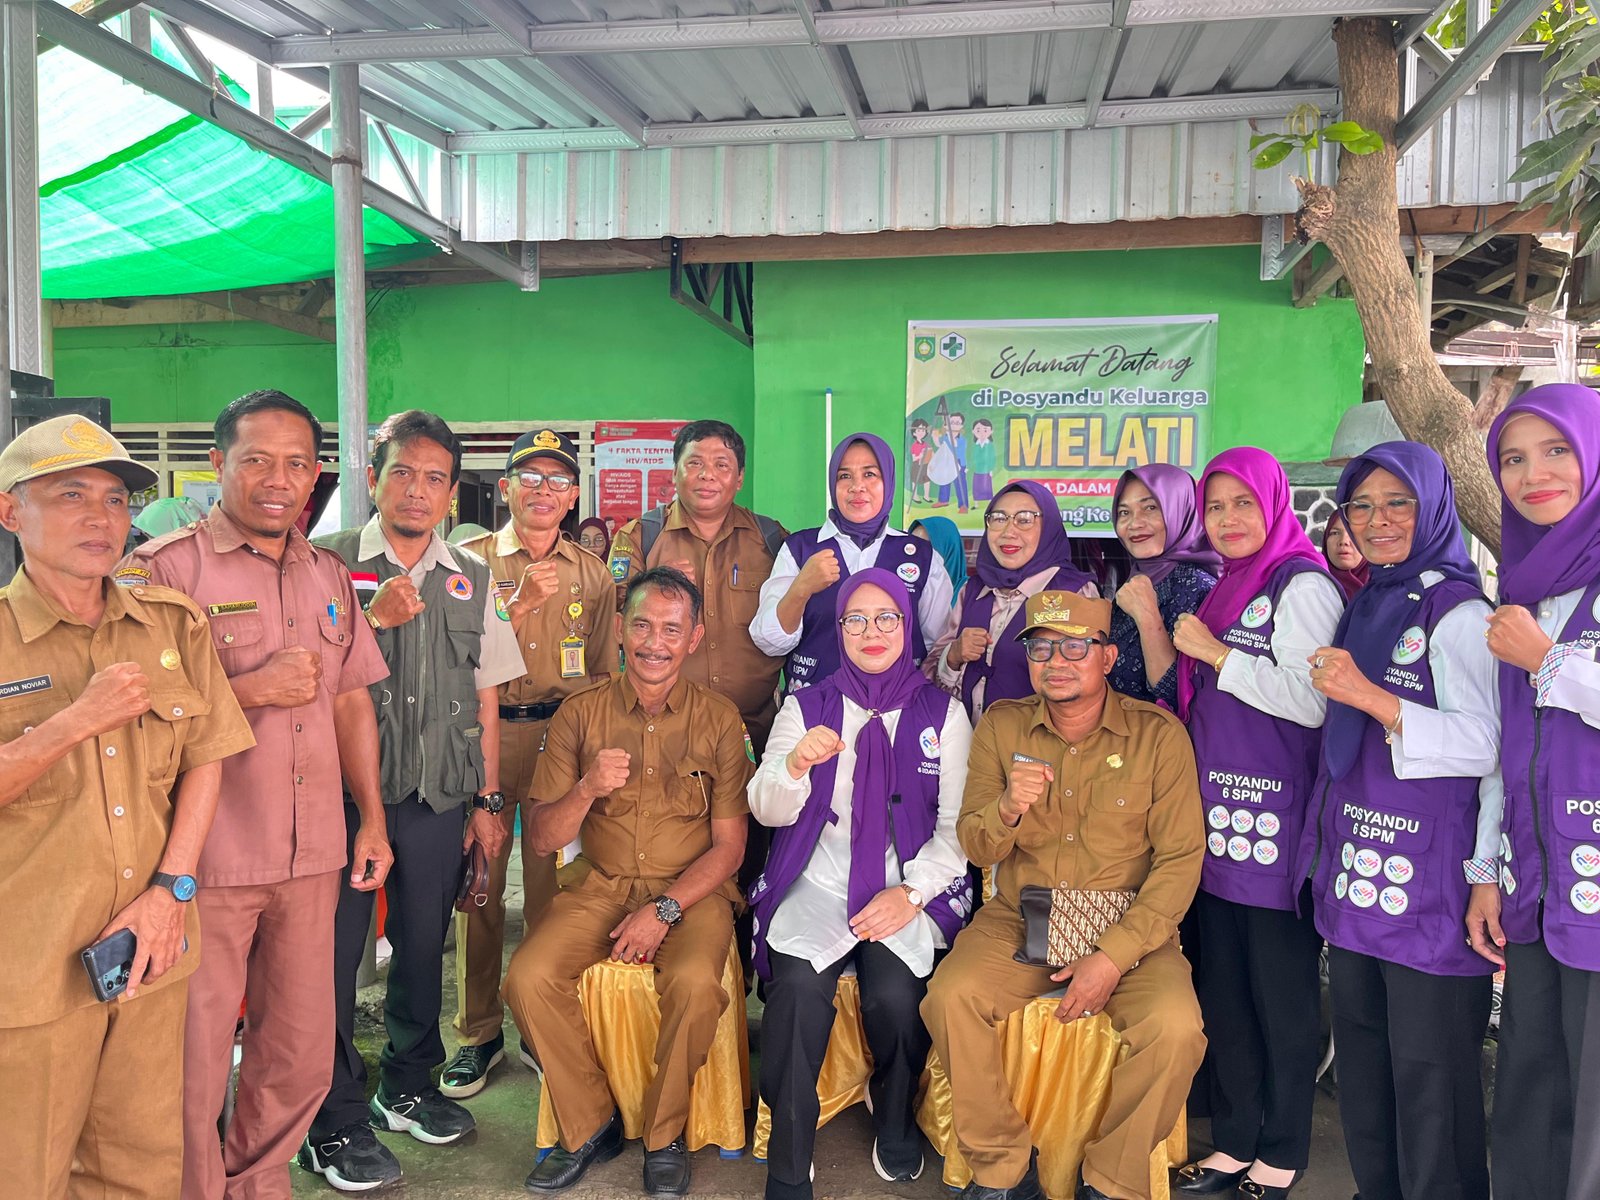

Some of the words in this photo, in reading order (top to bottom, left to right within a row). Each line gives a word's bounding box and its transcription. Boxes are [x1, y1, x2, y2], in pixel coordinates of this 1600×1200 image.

[990, 345, 1099, 379] Selamat
[1098, 344, 1195, 382] Datang
[972, 389, 993, 407] di
[999, 388, 1104, 410] Posyandu
[1109, 387, 1209, 408] Keluarga
[1008, 416, 1195, 467] MELATI
[616, 447, 641, 455] FAKTA
[644, 447, 674, 455] TENTAN
[1056, 482, 1111, 494] DALAM
[1253, 641, 1271, 651] SPM
[1386, 666, 1419, 682] SYANDU
[21, 680, 47, 690] NOVIAR
[1403, 680, 1424, 691] SPM
[1208, 771, 1282, 793] POSYANDU
[1222, 787, 1230, 799] 6
[1231, 788, 1263, 804] SPM
[1343, 803, 1419, 833] POSYANDU
[1352, 822, 1359, 835] 6
[1359, 824, 1395, 844] SPM
